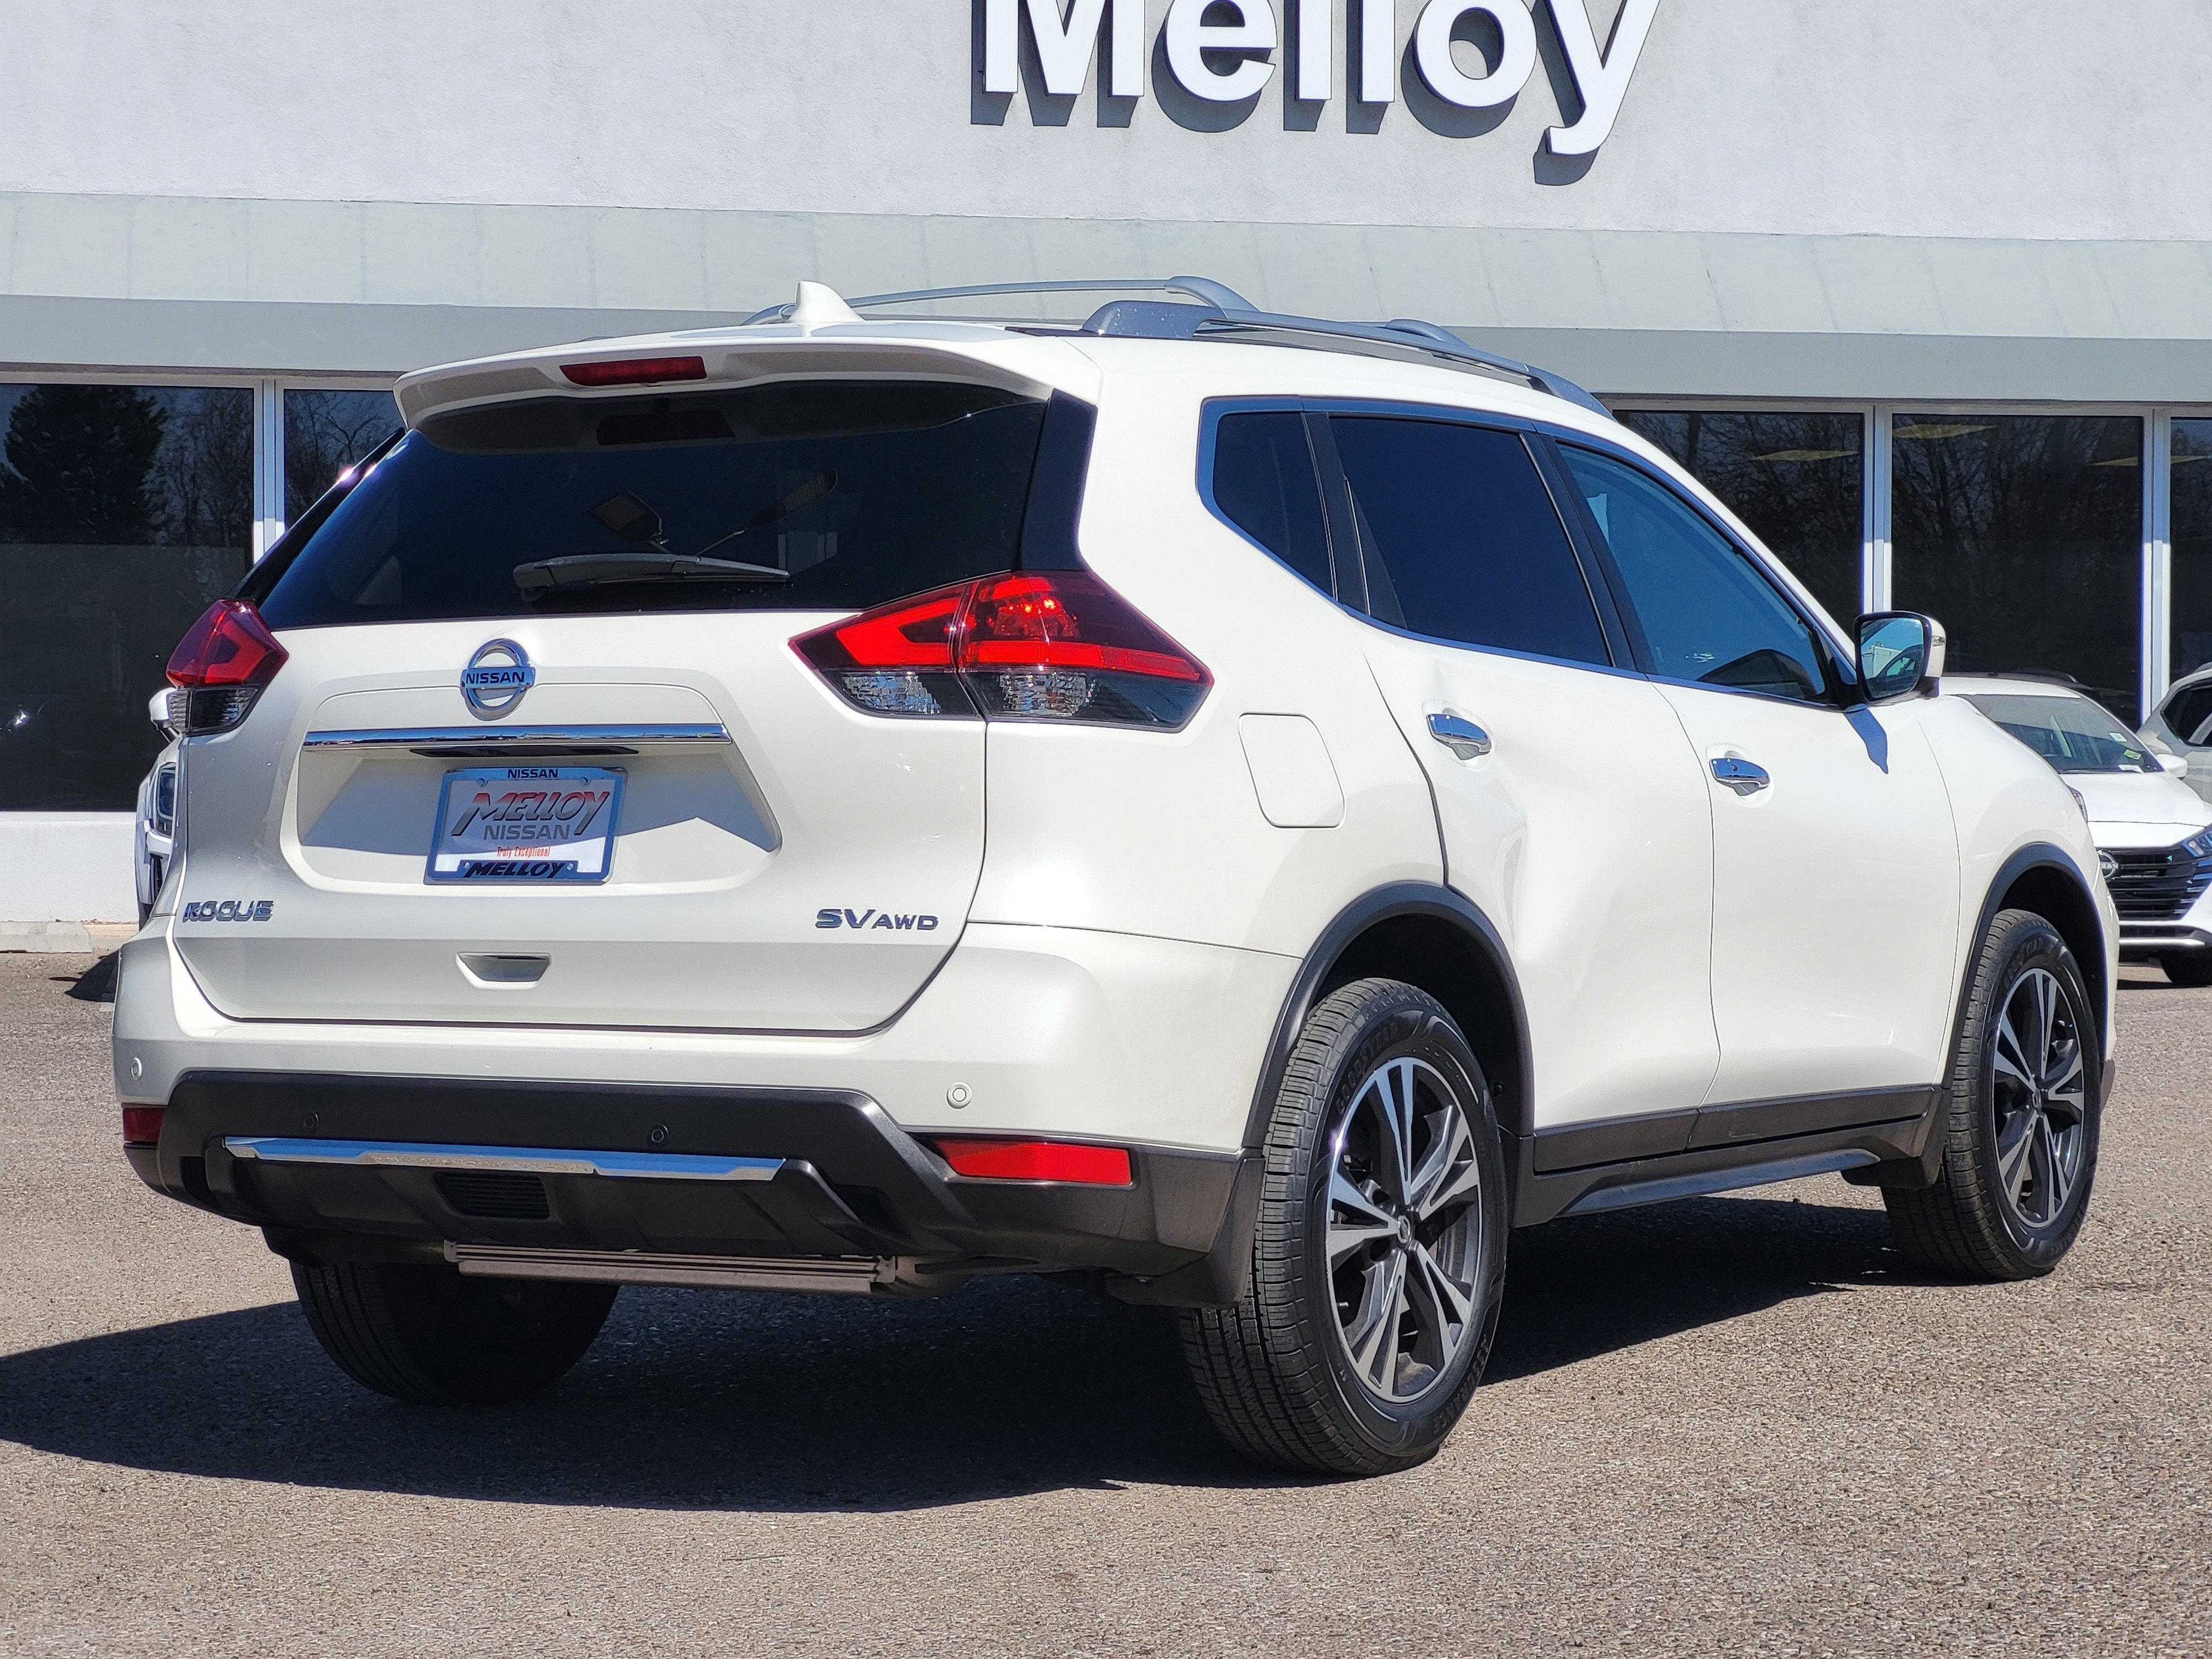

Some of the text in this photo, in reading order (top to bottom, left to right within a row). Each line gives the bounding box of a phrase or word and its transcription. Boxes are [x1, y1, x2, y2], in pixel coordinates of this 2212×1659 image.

[984, 0, 1661, 155] Melloy
[466, 671, 525, 685] NISSAN
[507, 769, 559, 779] NISSAN
[451, 791, 610, 837] MELLOY
[483, 825, 570, 840] NISSAN
[497, 846, 551, 858] Truly Exceptional
[463, 861, 565, 878] MELLOY
[182, 900, 274, 923] ROGUE
[1335, 1020, 1400, 1115] GOODYEAR
